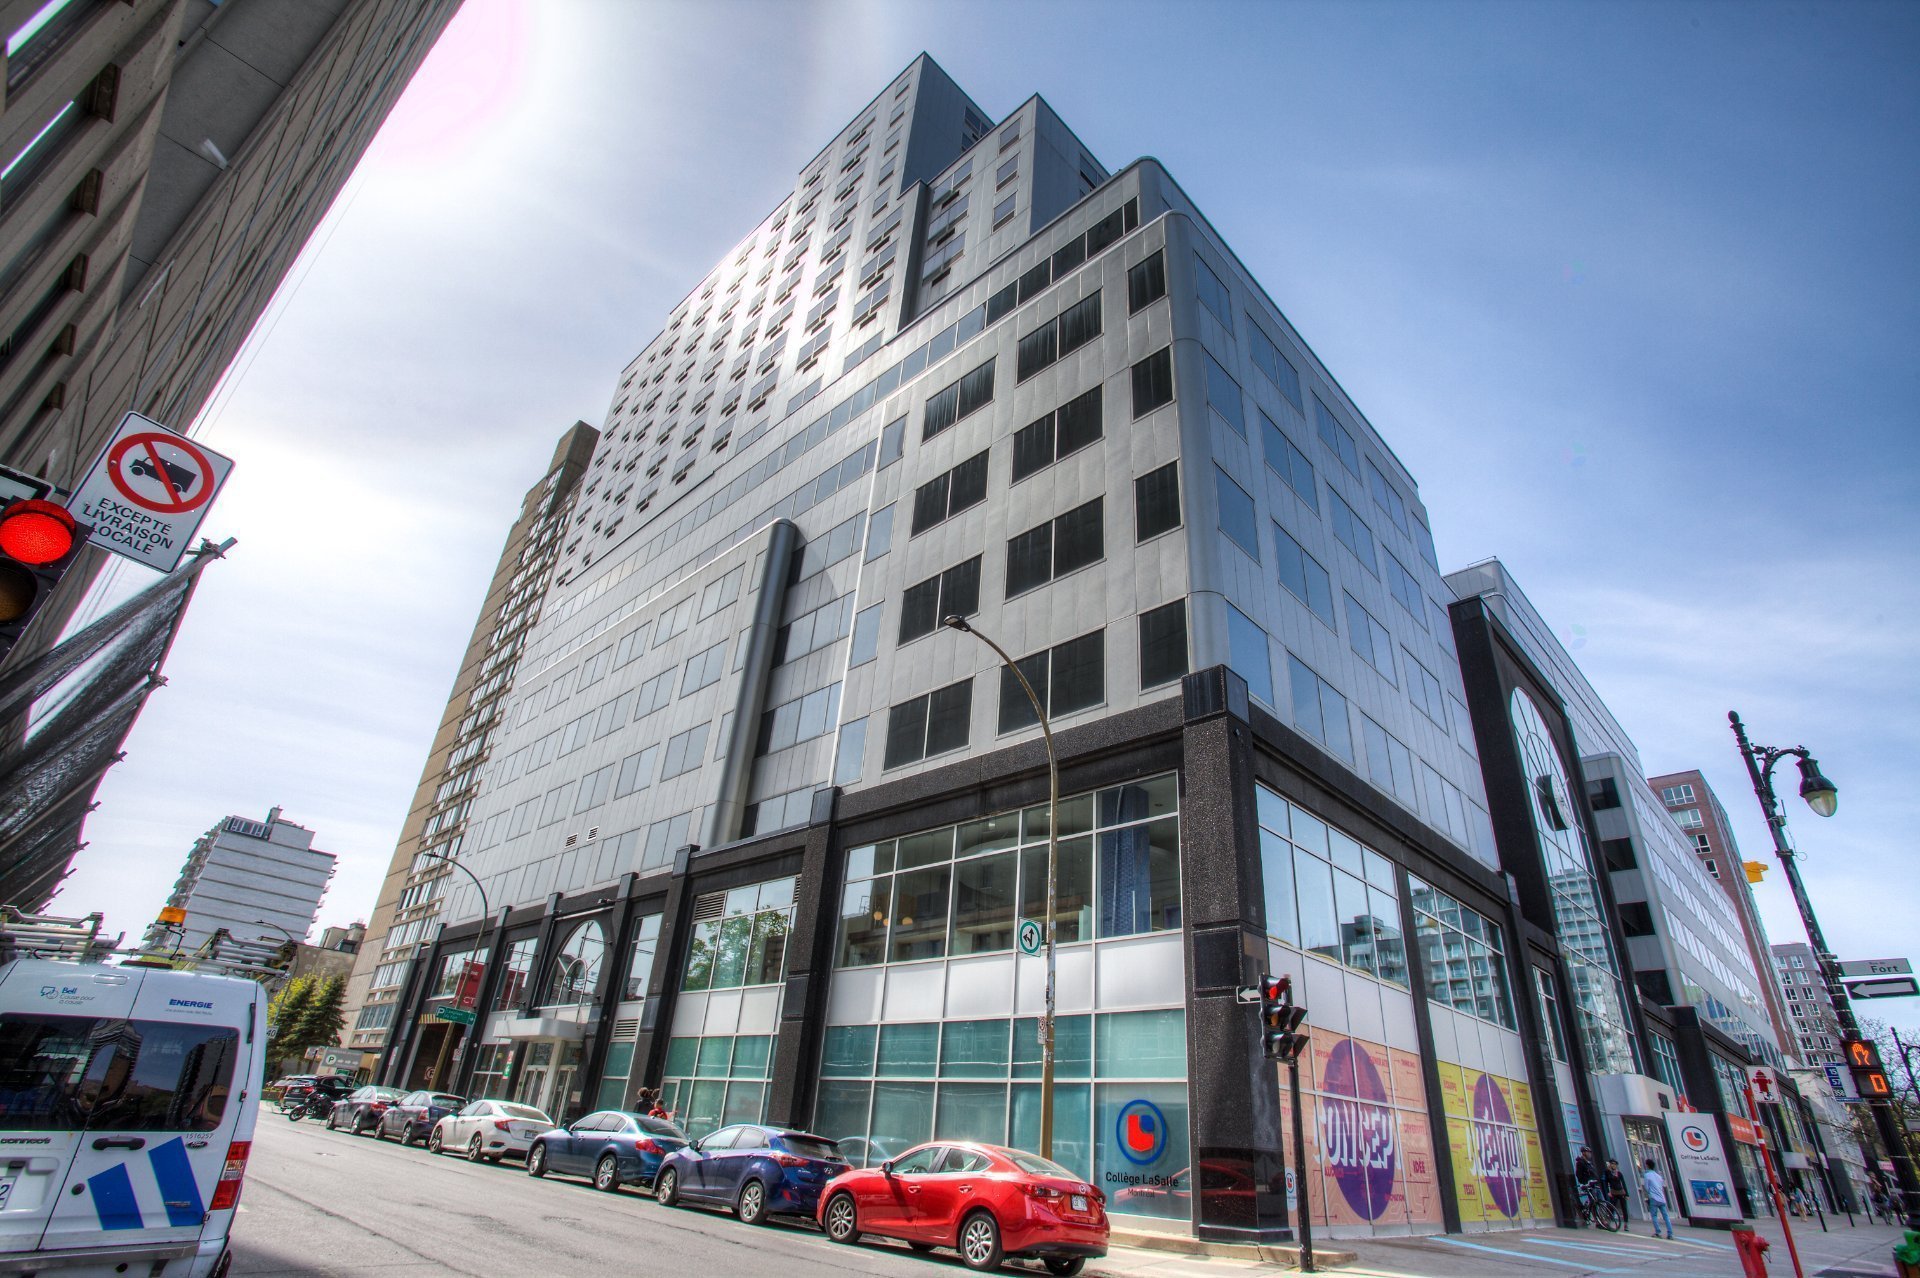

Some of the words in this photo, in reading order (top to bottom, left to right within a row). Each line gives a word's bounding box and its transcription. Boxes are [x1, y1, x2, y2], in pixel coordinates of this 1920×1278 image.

[98, 497, 172, 535] EXCEPTÉ
[83, 505, 174, 549] LIVRAISON
[92, 522, 155, 555] LOCALE
[1870, 965, 1900, 973] Fort
[62, 986, 78, 994] Bell
[1828, 1068, 1837, 1076] 15
[1105, 1171, 1140, 1186] Collège
[1142, 1174, 1180, 1187] LaSalle
